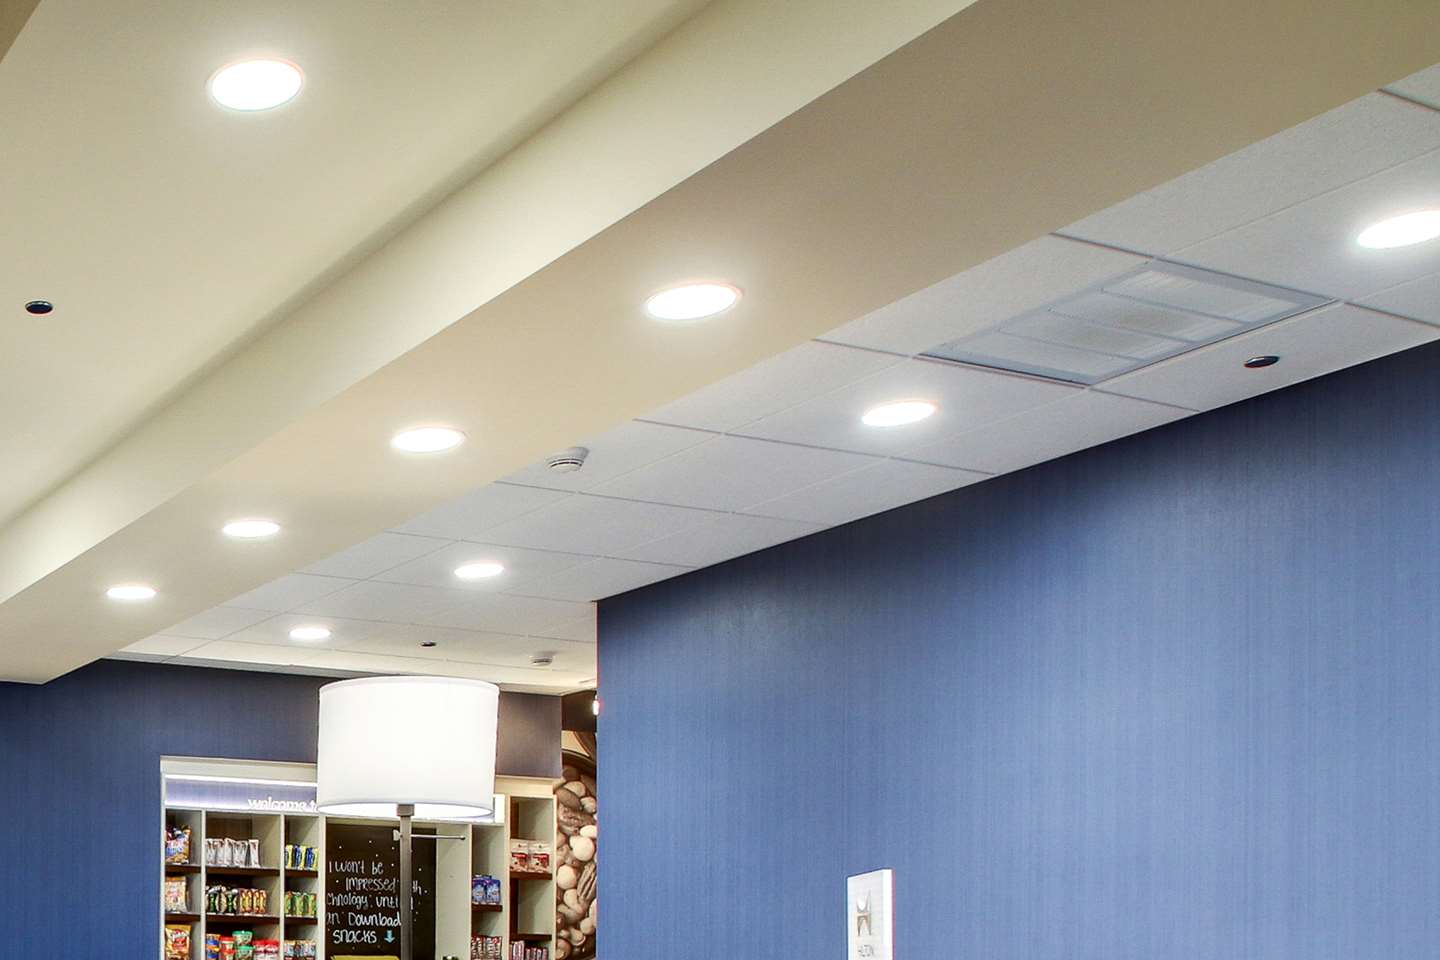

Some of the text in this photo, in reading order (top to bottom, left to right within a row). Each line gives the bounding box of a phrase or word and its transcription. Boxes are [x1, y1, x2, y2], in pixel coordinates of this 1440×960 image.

[334, 861, 365, 874] won't
[372, 861, 384, 875] be
[327, 892, 368, 910] chnology
